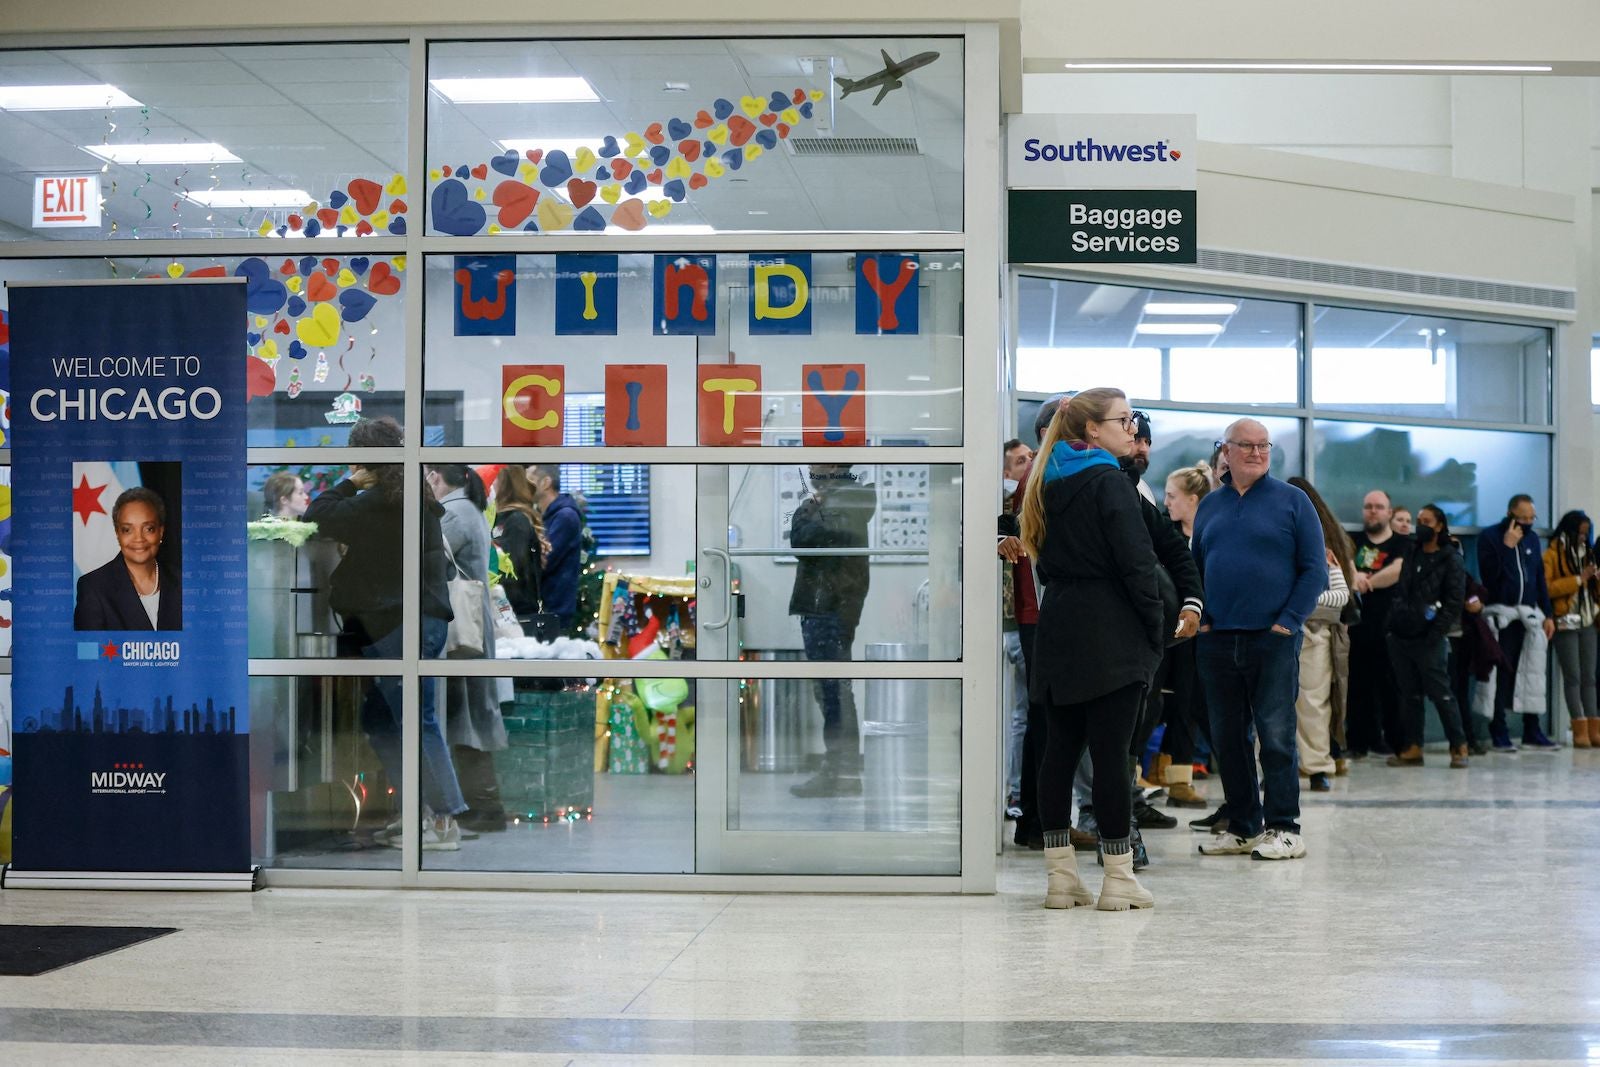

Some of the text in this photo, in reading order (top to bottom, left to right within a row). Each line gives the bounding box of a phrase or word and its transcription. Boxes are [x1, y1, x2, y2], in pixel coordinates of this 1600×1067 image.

[1024, 138, 1168, 162] Southwest
[43, 179, 88, 212] EXIT
[1069, 203, 1183, 230] Baggage
[1071, 231, 1180, 253] Services
[52, 356, 200, 378] WELCOME TO
[30, 386, 222, 421] CHICAGO
[503, 369, 860, 442] CITY
[122, 641, 180, 660] CHICAGO
[91, 772, 167, 788] MIDWAY
